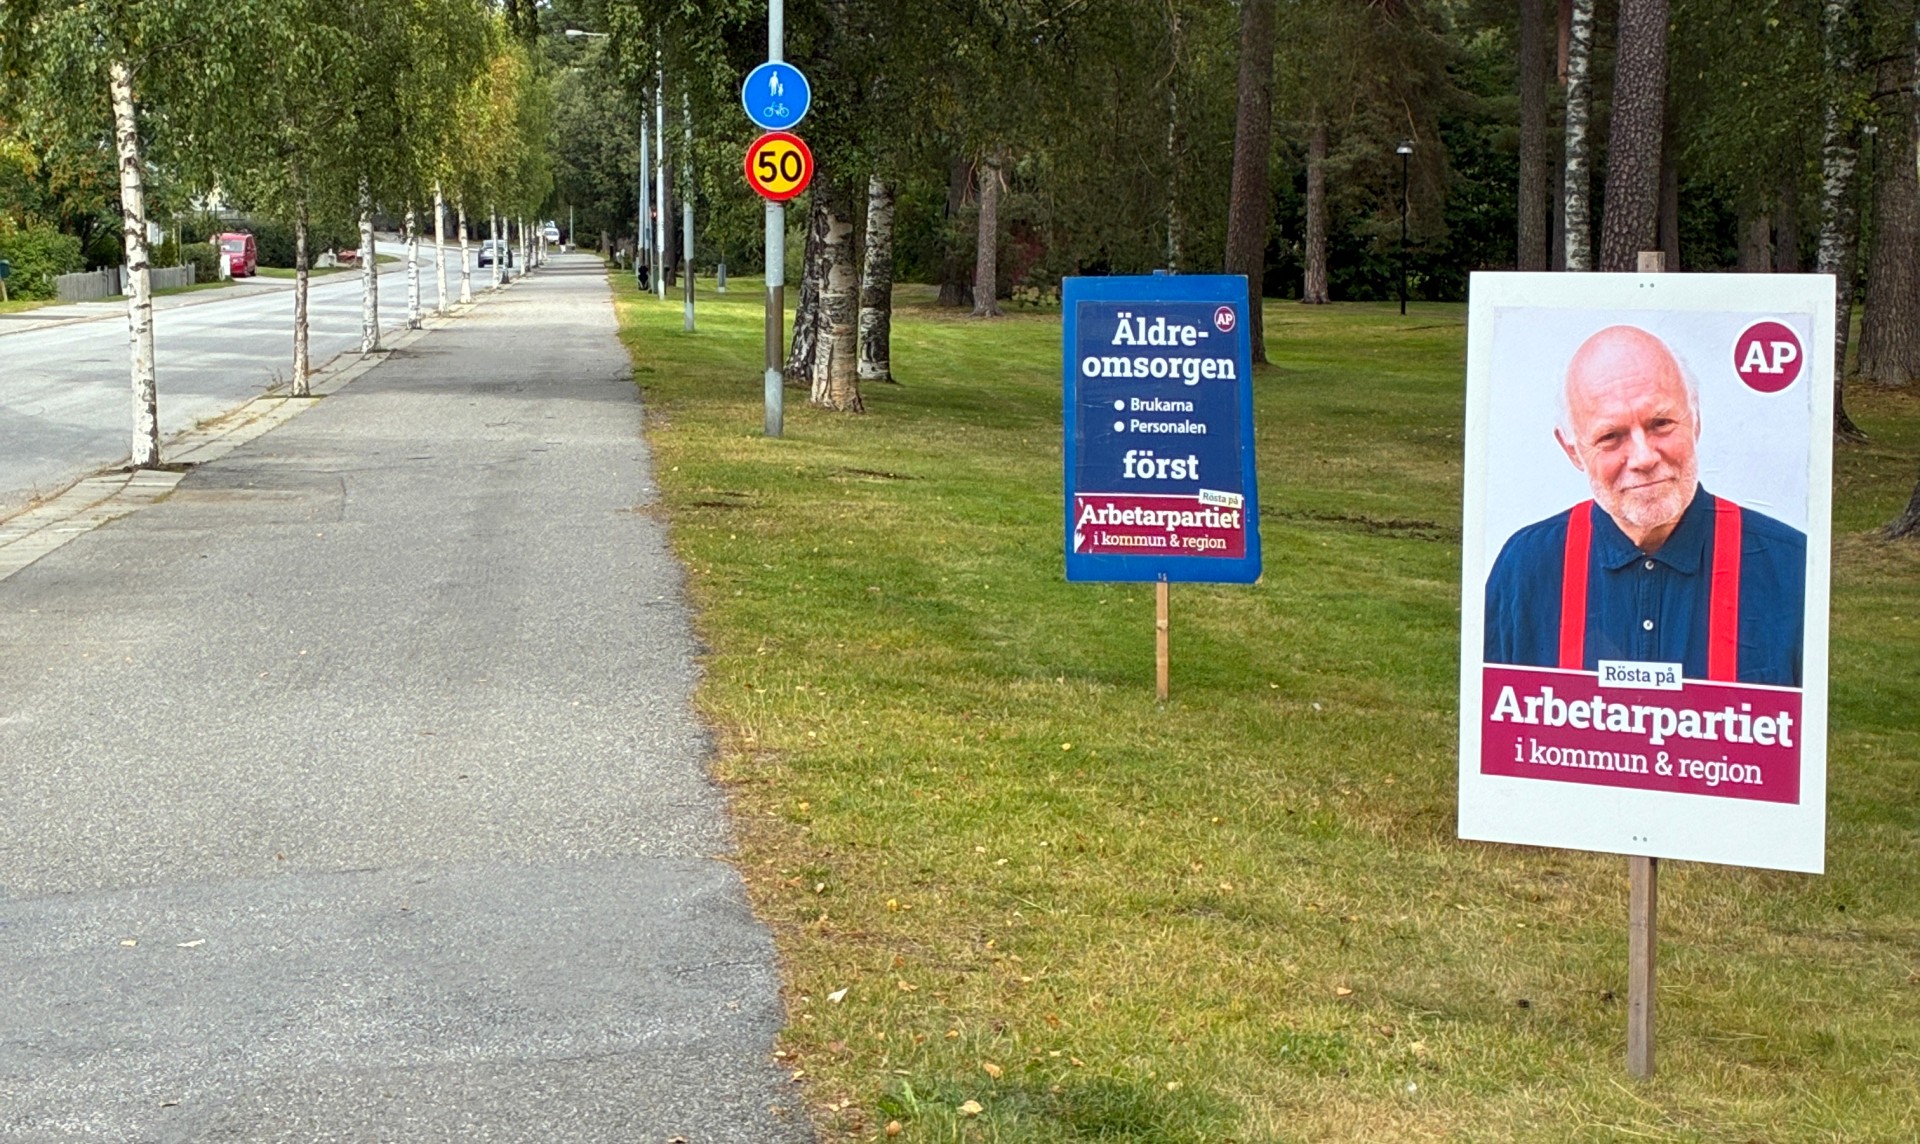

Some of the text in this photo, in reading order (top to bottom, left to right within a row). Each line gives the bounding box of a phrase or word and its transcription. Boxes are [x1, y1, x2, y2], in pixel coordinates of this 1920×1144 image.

[758, 150, 802, 183] 50
[1111, 312, 1209, 346] Äldre-
[1216, 312, 1234, 325] AP
[1082, 356, 1236, 385] omsorgen
[1740, 340, 1797, 374] AP
[1130, 397, 1193, 412] Brukarna
[1130, 419, 1206, 434] Personalen
[1123, 450, 1200, 480] först
[1202, 491, 1239, 506] Rösta på
[1080, 503, 1240, 531] Arbetarpartiet
[1093, 531, 1227, 551] i kommun & region
[1604, 666, 1676, 686] Rösta på
[1490, 685, 1794, 748] Arbetarpartiet
[1514, 737, 1763, 787] i kommun & region
